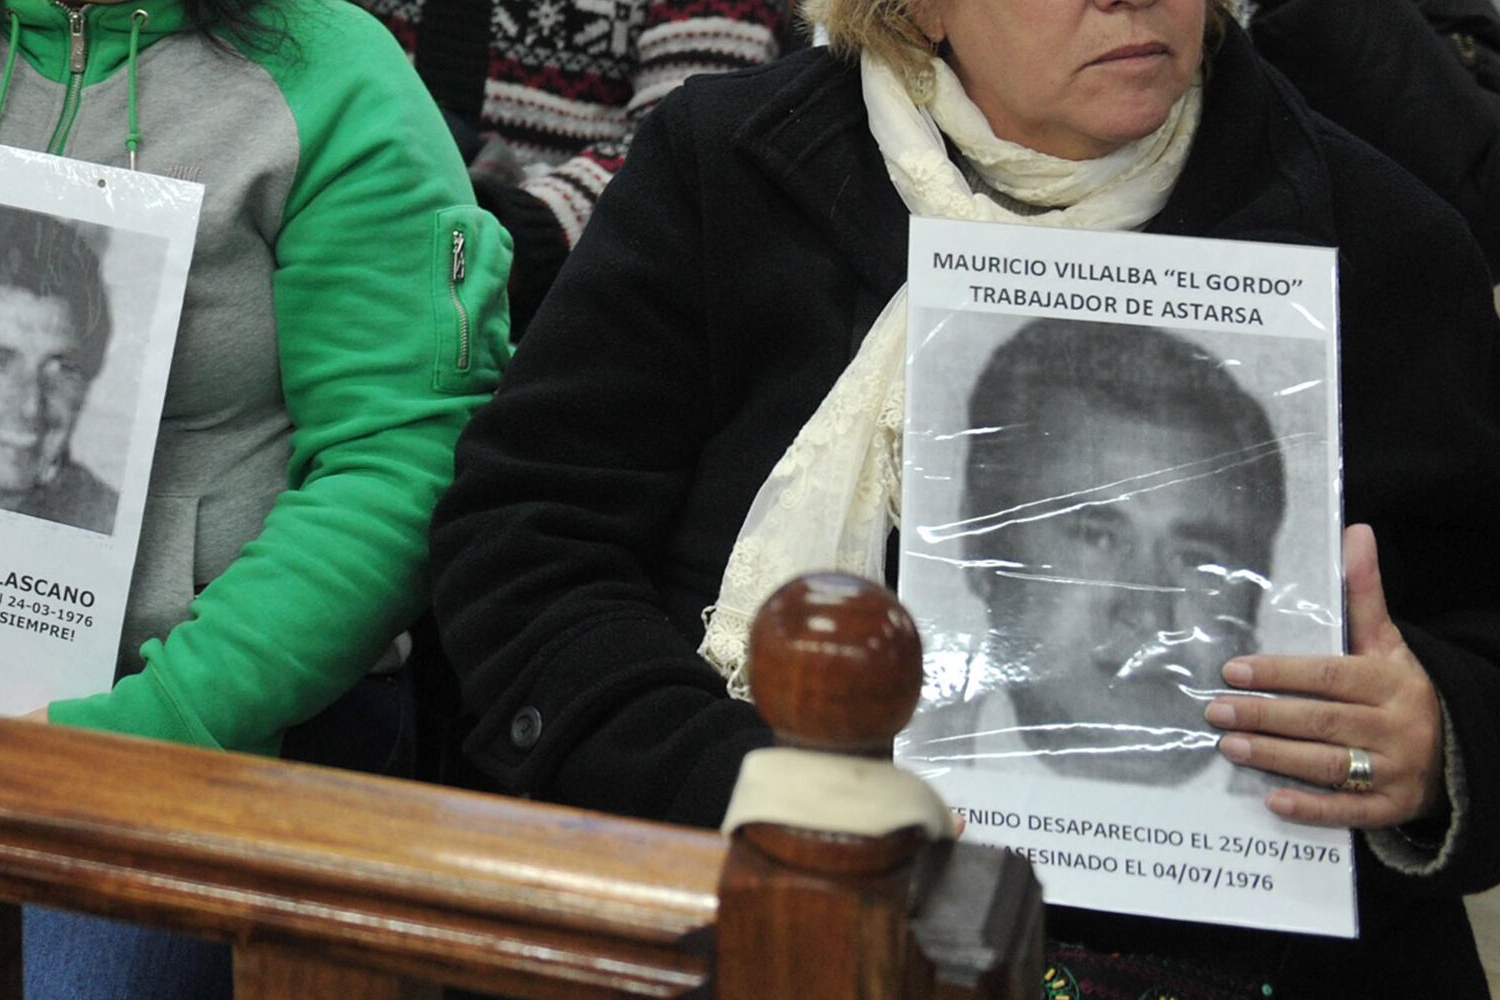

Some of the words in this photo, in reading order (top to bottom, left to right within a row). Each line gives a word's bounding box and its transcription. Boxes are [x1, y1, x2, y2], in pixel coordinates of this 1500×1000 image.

[933, 252, 1047, 277] MAURICIO
[1054, 261, 1158, 286] VILLALBA
[1163, 269, 1200, 290] “EL
[1205, 274, 1303, 296] GORDO”
[970, 285, 1117, 314] TRABAJADOR
[1126, 297, 1154, 316] DE
[1161, 301, 1264, 326] ASTARSA
[0, 611, 76, 642] SIEMPRE!
[8, 596, 93, 627] 24-03-1976
[1028, 814, 1184, 848] DESAPARECIDO
[1191, 833, 1213, 851] EL
[1219, 835, 1340, 865] 25/05/1976
[1125, 858, 1147, 877] EL
[1152, 862, 1275, 892] 04/07/1976
